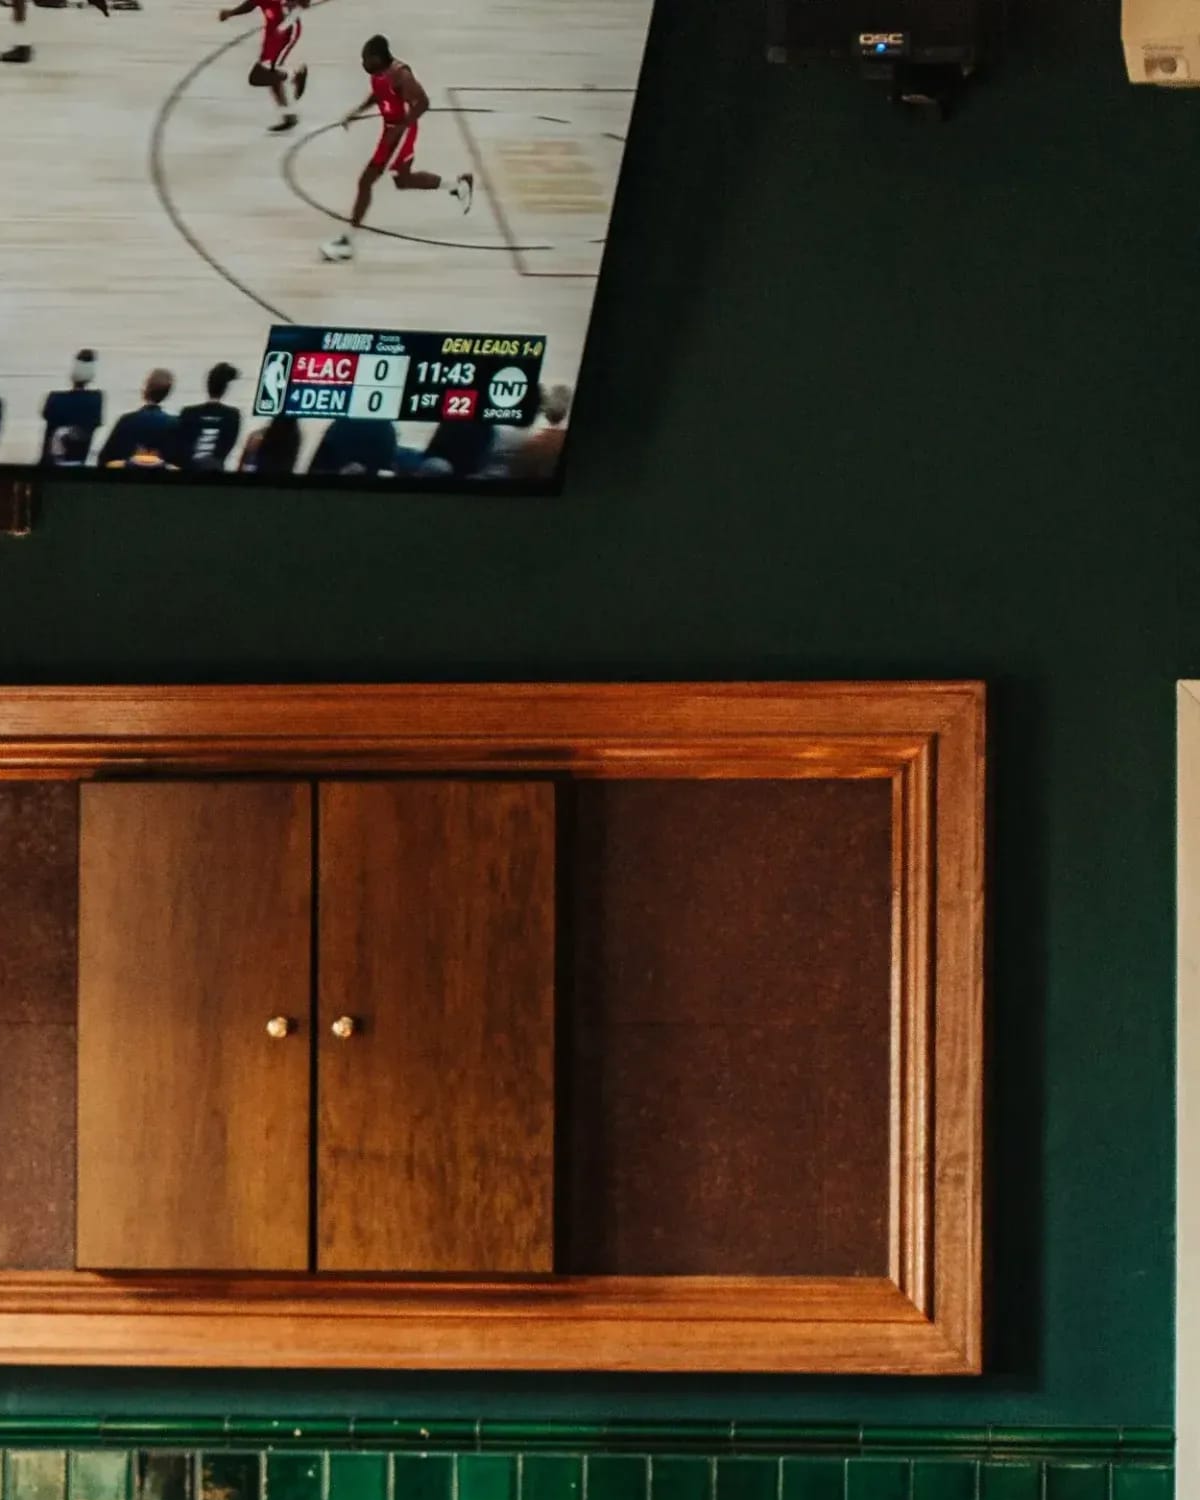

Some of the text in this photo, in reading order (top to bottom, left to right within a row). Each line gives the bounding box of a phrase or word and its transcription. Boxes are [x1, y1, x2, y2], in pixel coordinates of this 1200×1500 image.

[441, 337, 544, 357] DEN LEADS 1-0
[307, 357, 352, 379] LAC
[374, 359, 389, 381] 0
[417, 360, 476, 385] 11:43
[301, 388, 346, 411] DEN
[368, 391, 383, 413] 0
[410, 393, 440, 412] 1ST
[446, 396, 472, 415] 22
[483, 407, 523, 419] SPORTS
